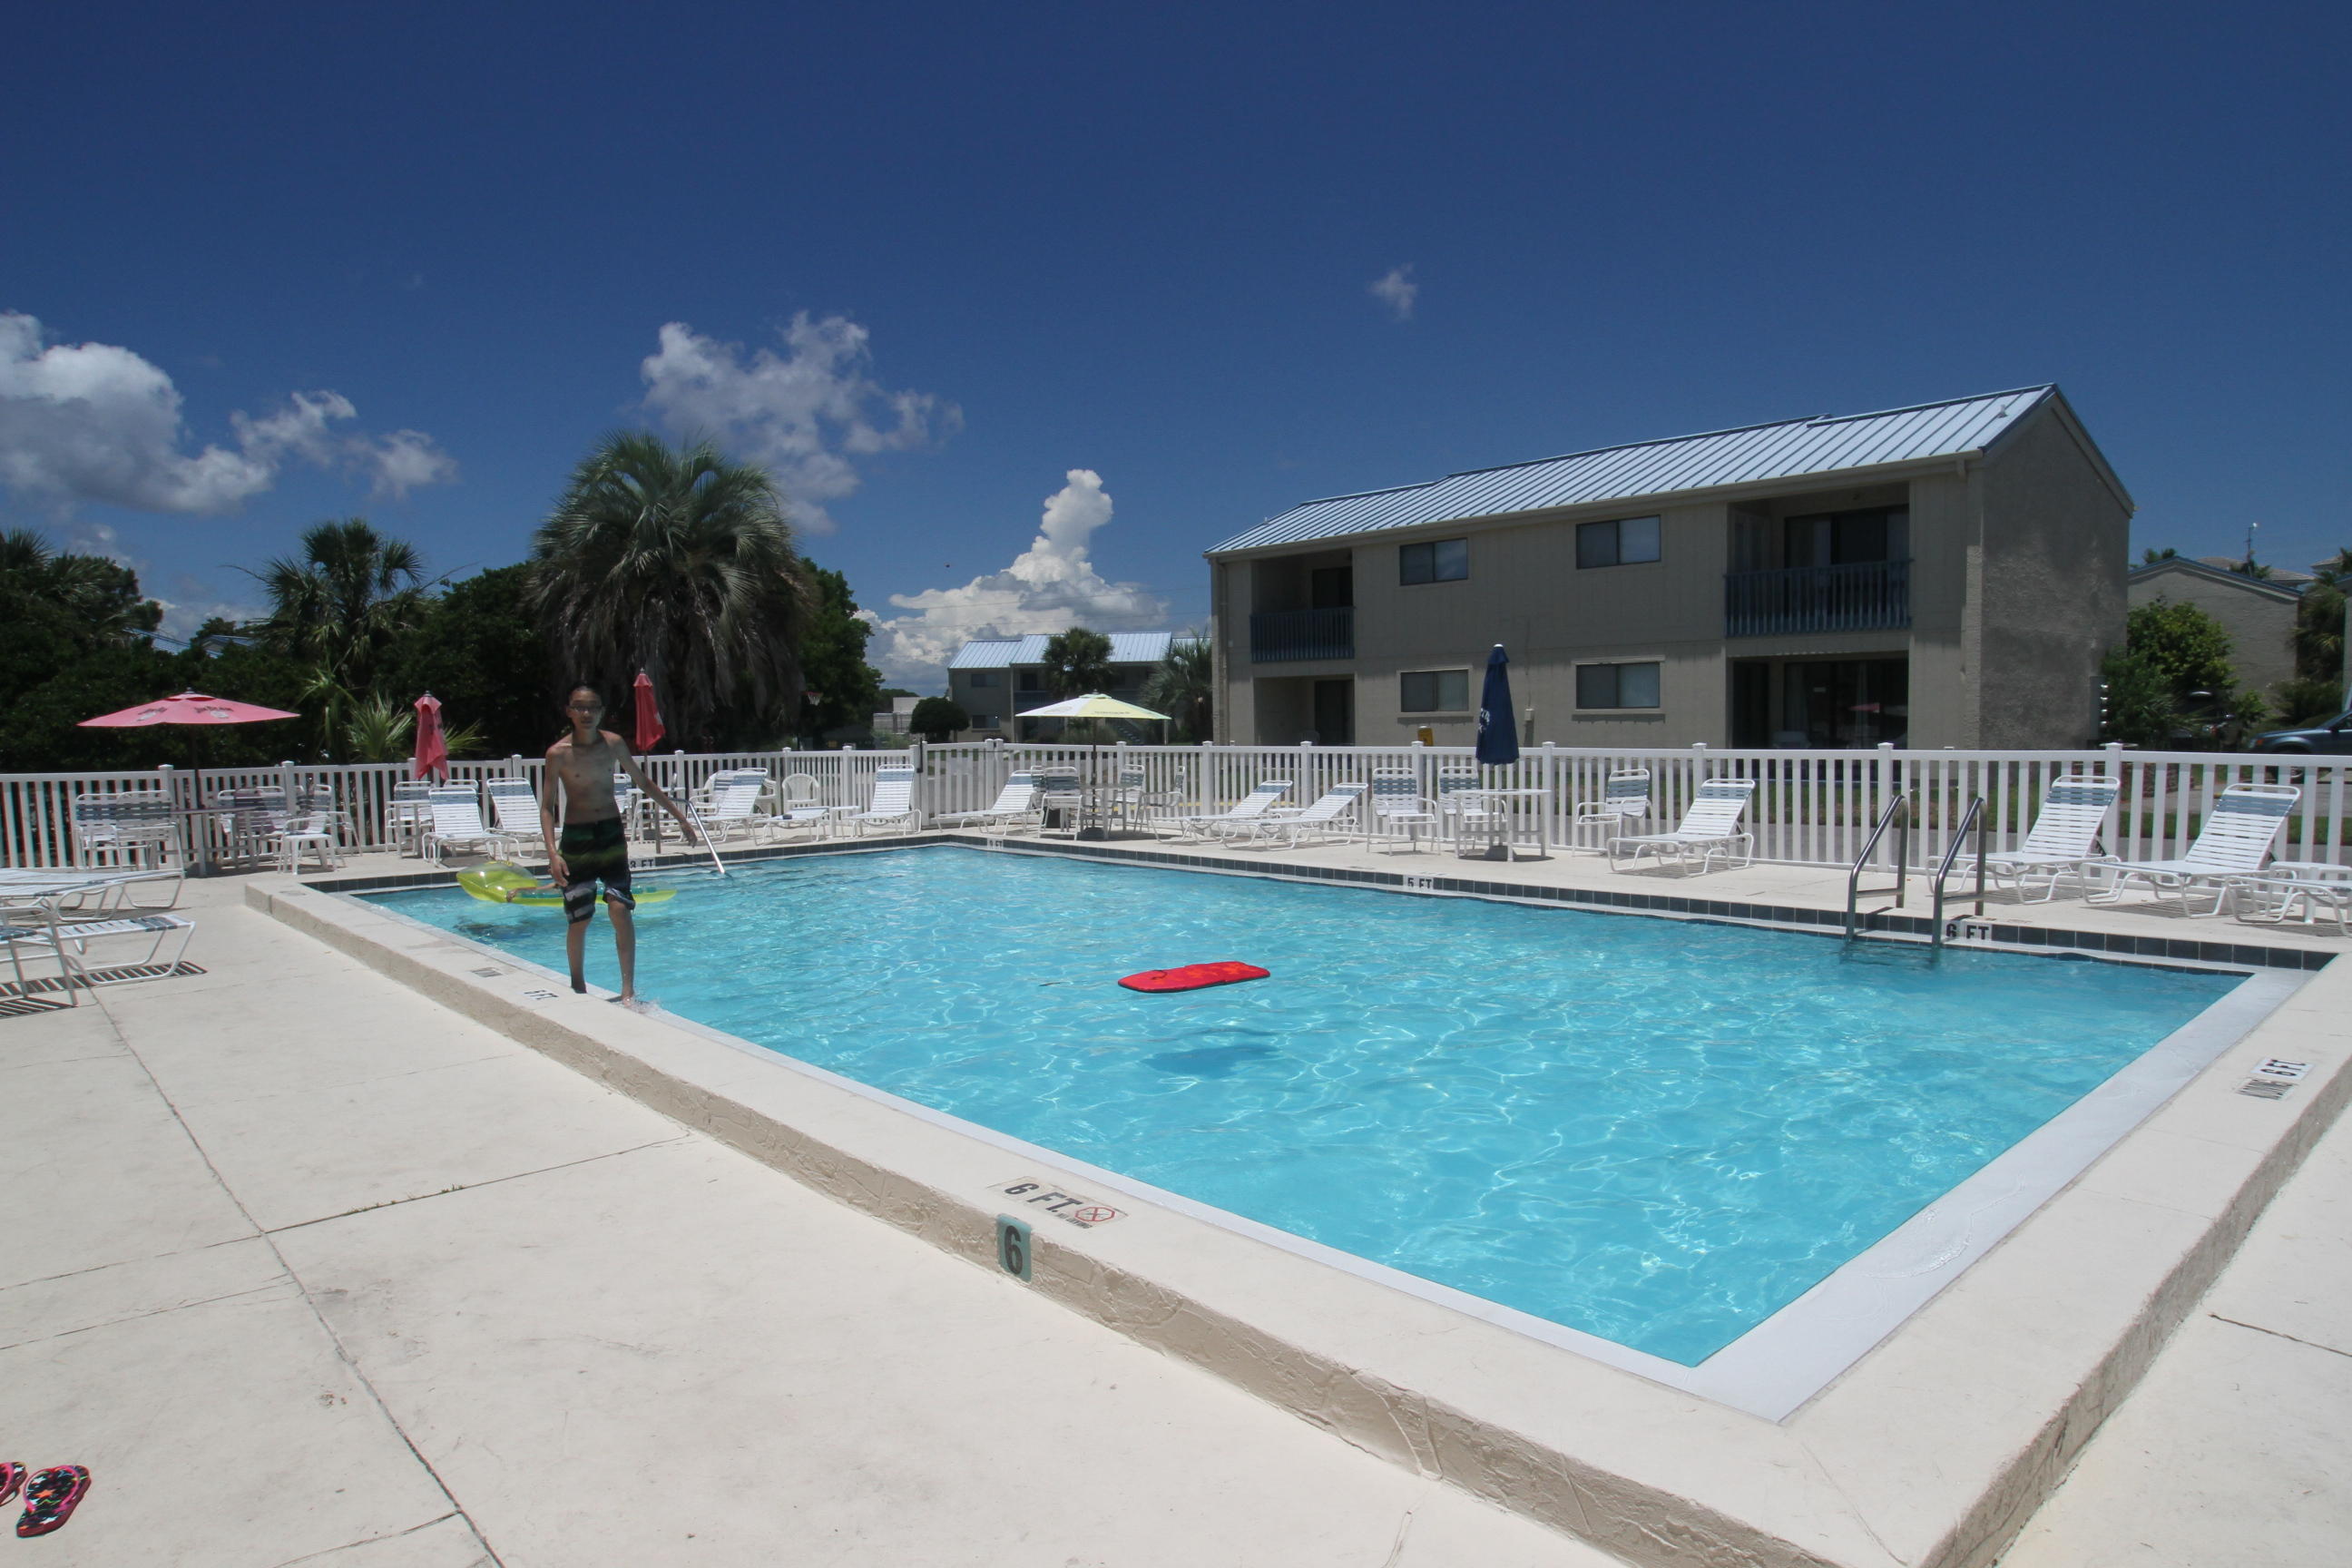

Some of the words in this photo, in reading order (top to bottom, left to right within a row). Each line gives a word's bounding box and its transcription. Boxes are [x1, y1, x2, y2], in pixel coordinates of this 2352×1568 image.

[641, 858, 654, 868] FT
[1407, 877, 1415, 887] 5
[1418, 878, 1432, 888] FT
[1945, 923, 1957, 937] 6
[1966, 925, 1989, 940] FT
[2266, 1059, 2307, 1071] FT
[2260, 1068, 2298, 1076] 6
[1004, 1183, 1040, 1194] 6
[1004, 1225, 1024, 1275] 6
